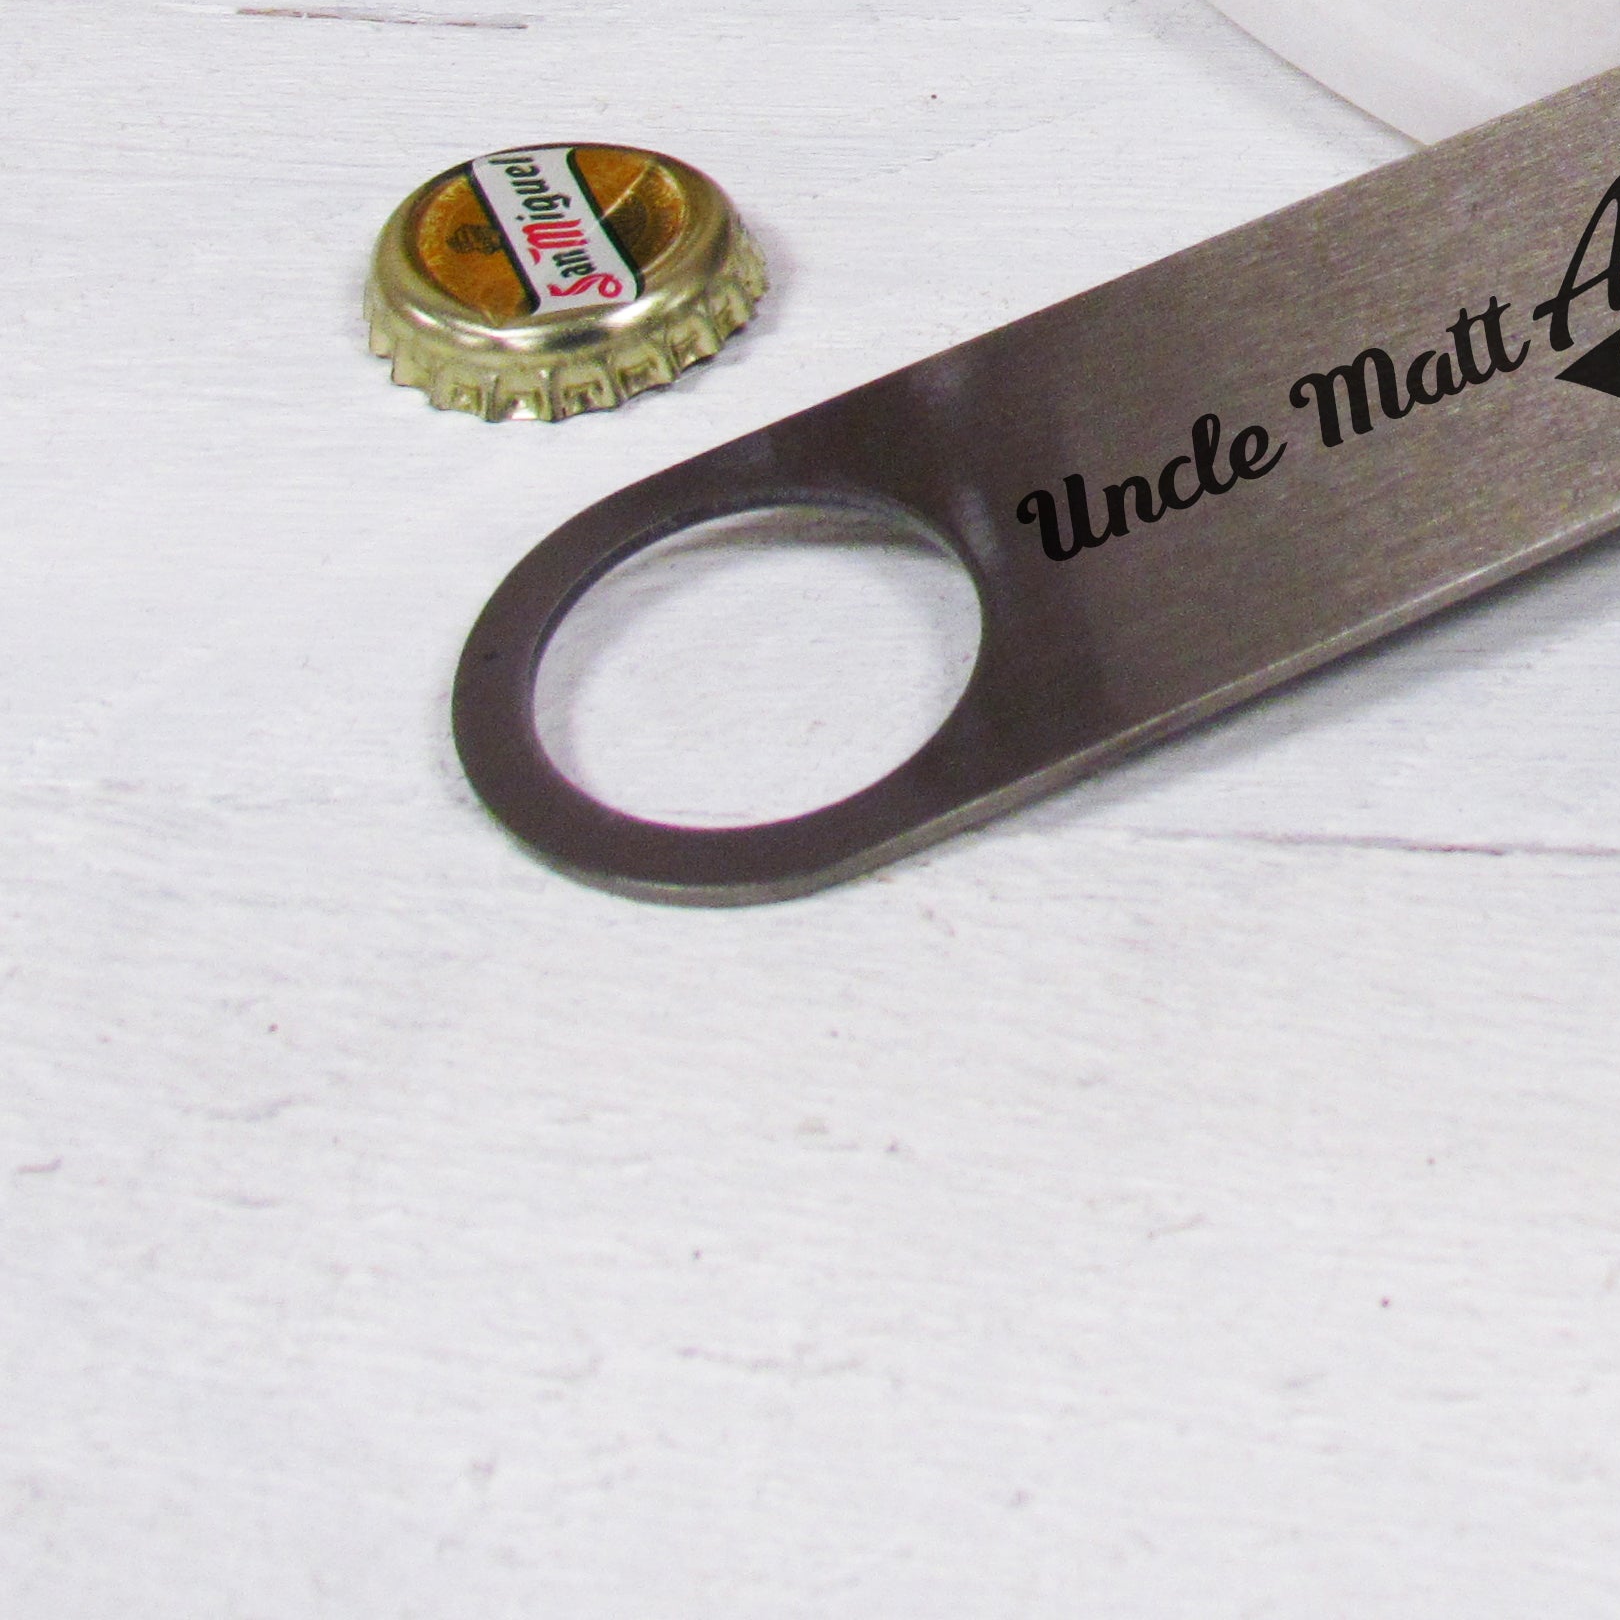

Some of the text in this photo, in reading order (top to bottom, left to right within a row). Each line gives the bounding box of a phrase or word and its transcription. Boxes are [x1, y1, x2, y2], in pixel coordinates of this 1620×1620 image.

[488, 156, 624, 299] San Miguel
[1015, 413, 1288, 562] Uncle
[1288, 295, 1531, 448] Matt
